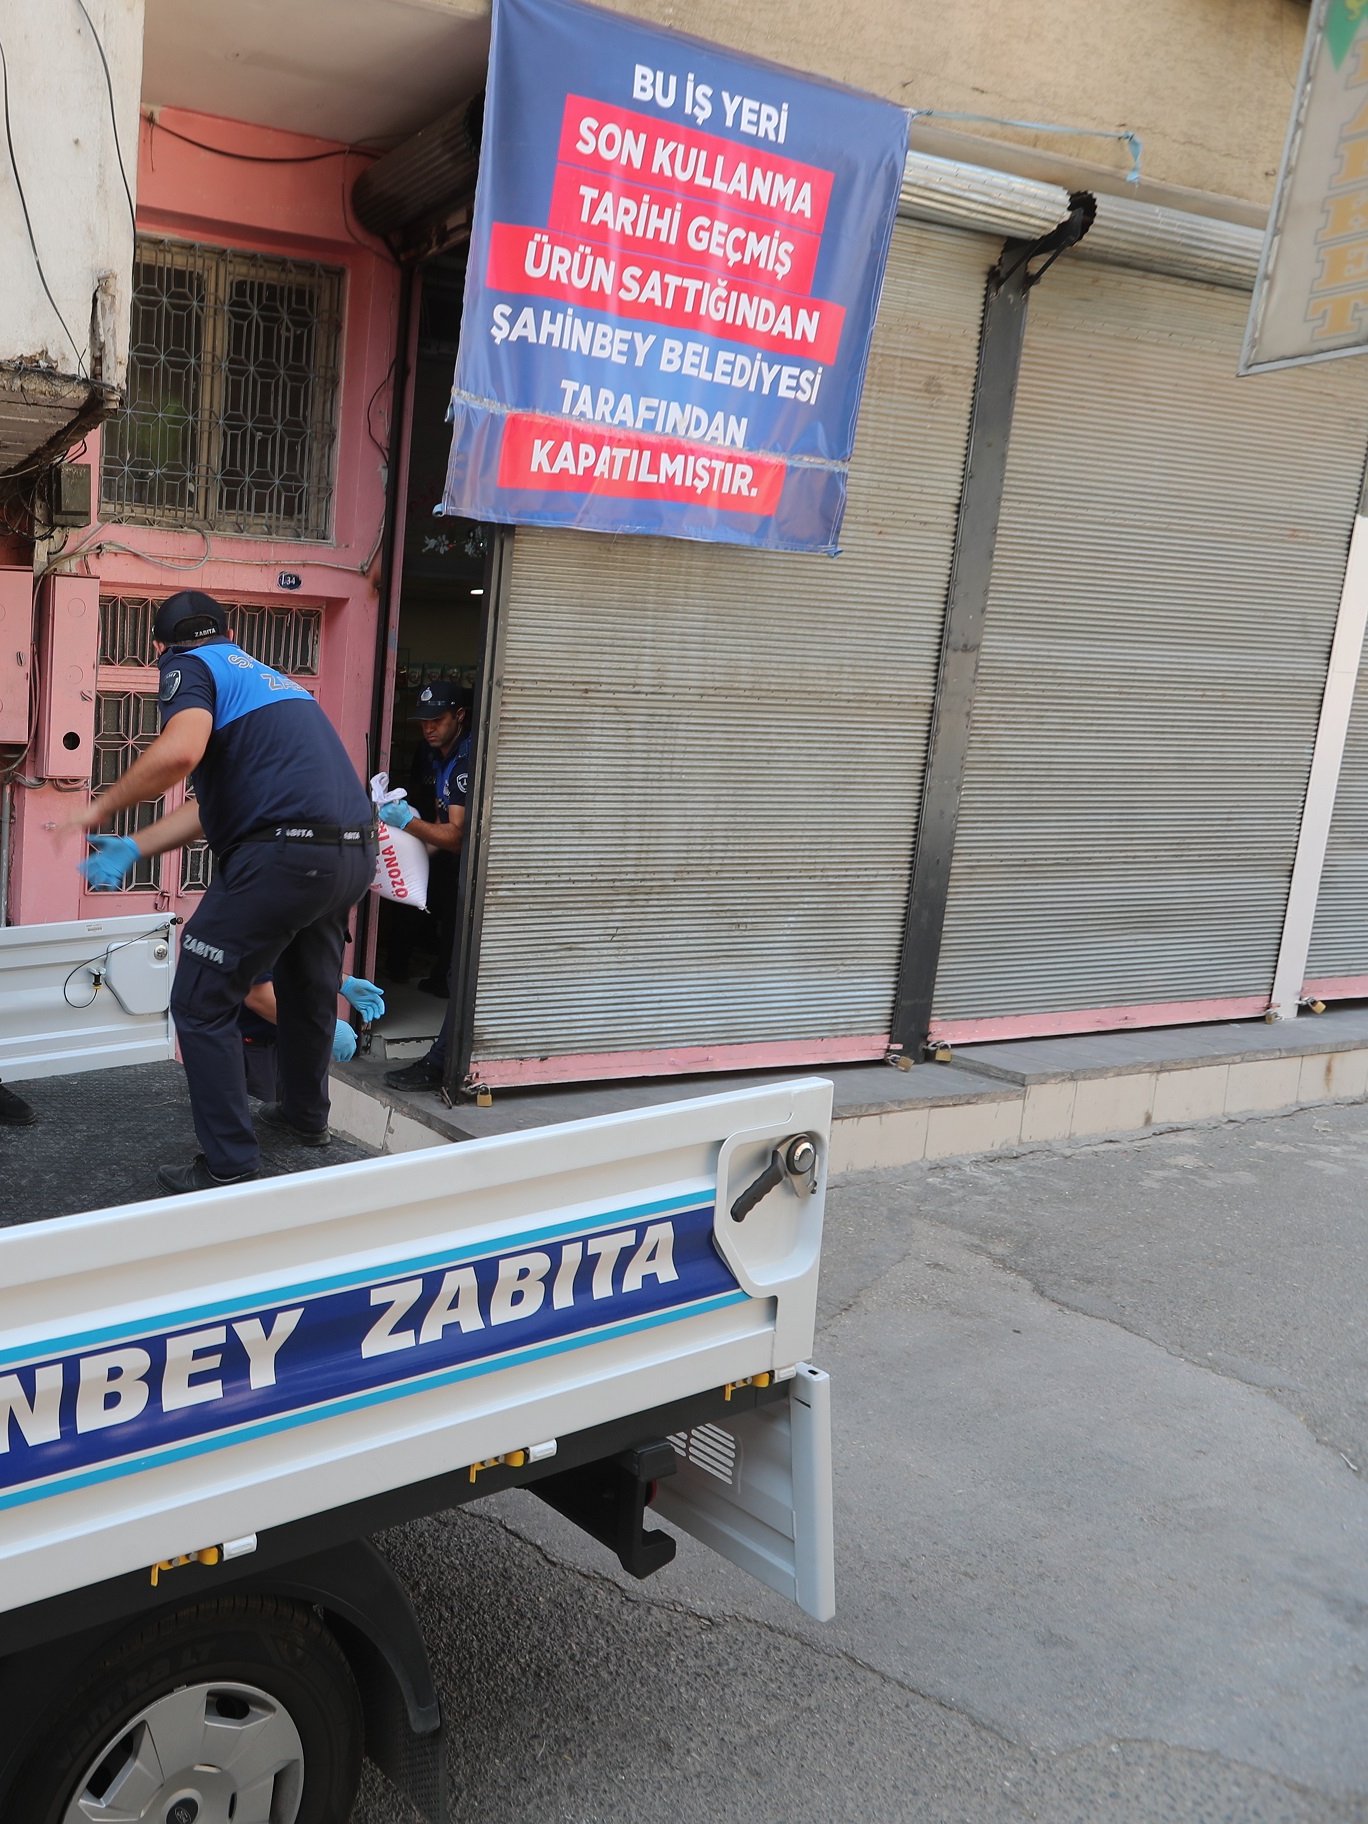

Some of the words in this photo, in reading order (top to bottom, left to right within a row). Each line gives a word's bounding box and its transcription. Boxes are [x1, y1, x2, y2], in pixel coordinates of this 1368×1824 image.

[632, 63, 677, 108] BU
[684, 72, 713, 124] İŞ
[720, 91, 789, 144] YERİ
[576, 116, 646, 170] SON
[651, 143, 813, 219] KULLANMA
[579, 186, 681, 246] TARİHİ
[687, 217, 794, 280] GEÇMİŞ
[524, 233, 616, 295] ÜRÜN
[618, 266, 820, 343] SATTIĞINDAN
[490, 303, 655, 367] ŞAHİNBEY
[660, 339, 823, 405] BELEDİYESİ
[560, 379, 748, 447] TARAFINDAN
[530, 439, 758, 497] KAPATILMIŞTIR.
[194, 627, 216, 638] ZABITA
[381, 844, 408, 899] ÖZONA
[182, 933, 225, 965] ZABITA
[360, 1220, 680, 1360] ZABITA
